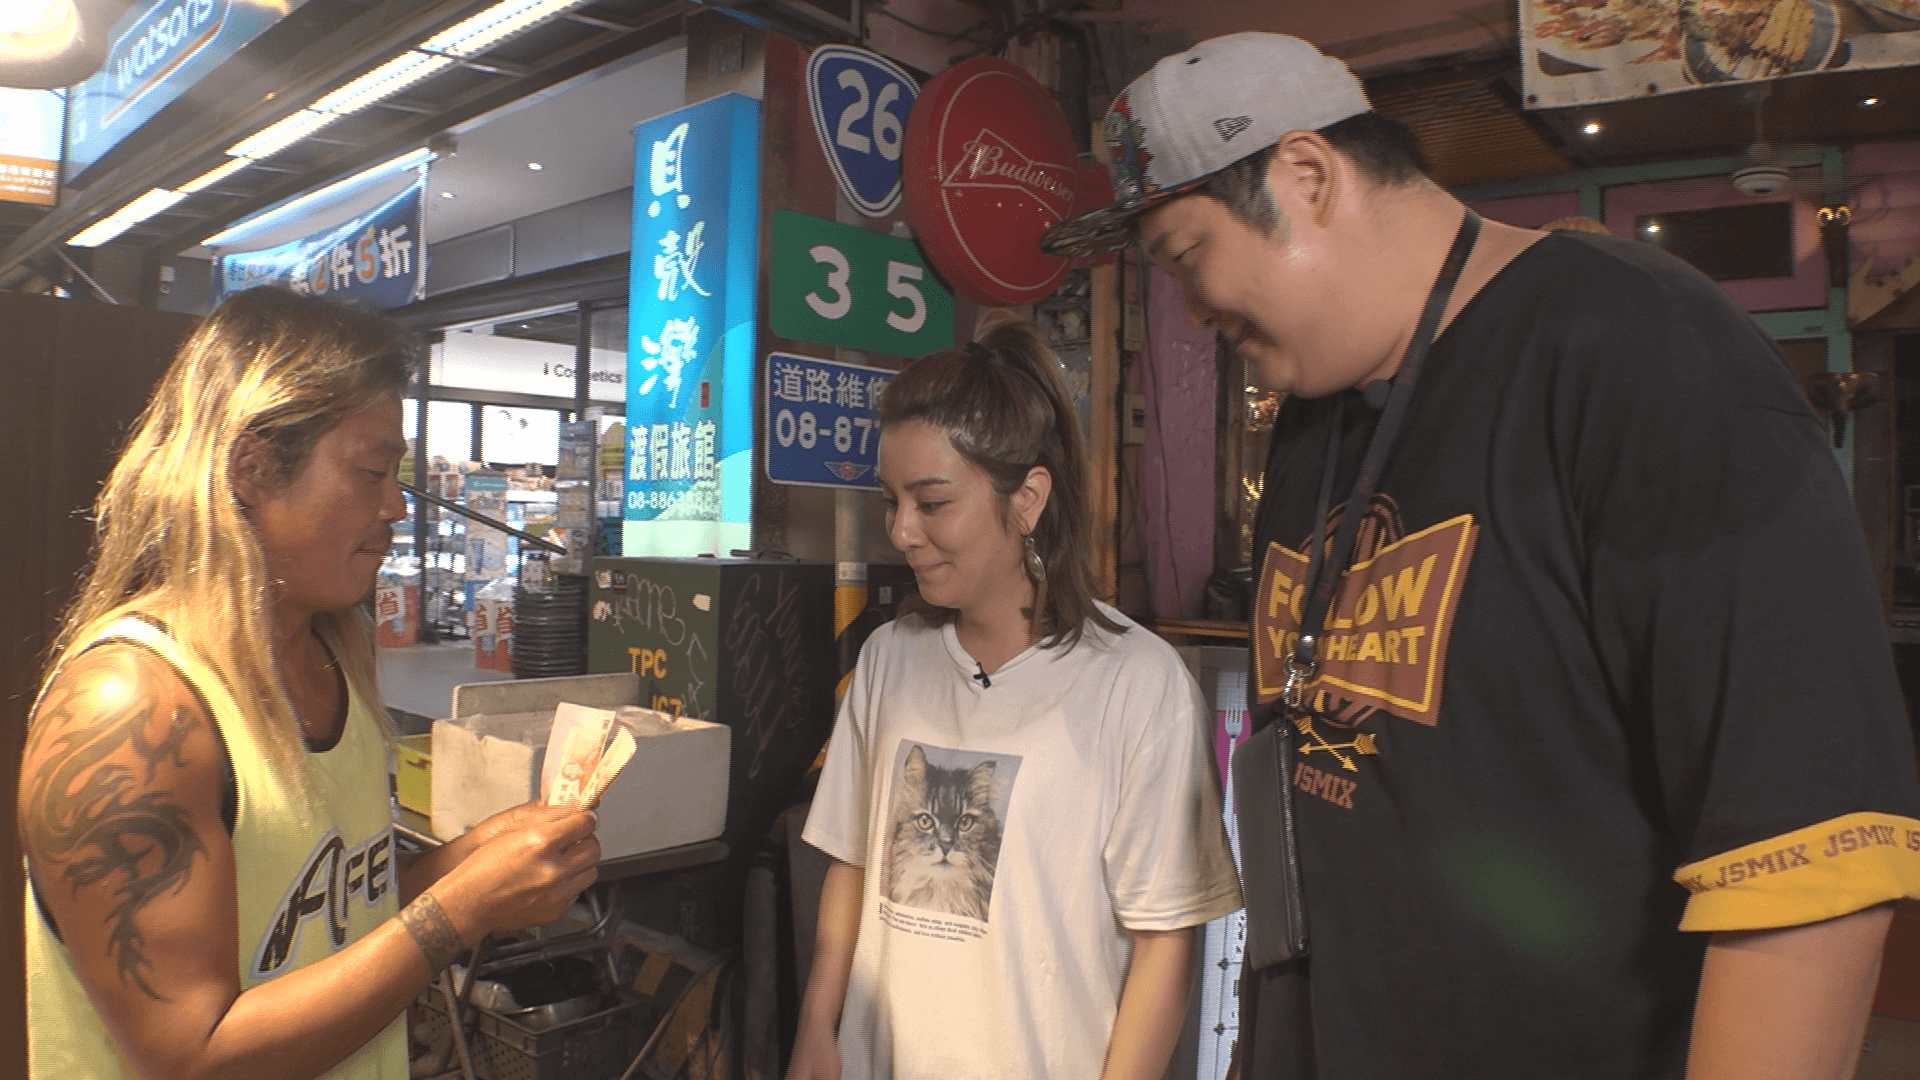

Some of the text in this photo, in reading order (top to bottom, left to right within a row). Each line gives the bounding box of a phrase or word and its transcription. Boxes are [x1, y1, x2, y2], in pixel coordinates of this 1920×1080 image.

[117, 0, 215, 91] watsons
[836, 68, 903, 161] 26
[553, 363, 623, 384] Coetics
[775, 408, 881, 455] 08-87
[1269, 553, 1438, 629] FOLOW
[628, 647, 668, 680] TPC
[1326, 625, 1426, 665] HEART
[1715, 843, 1811, 889] JSMIX
